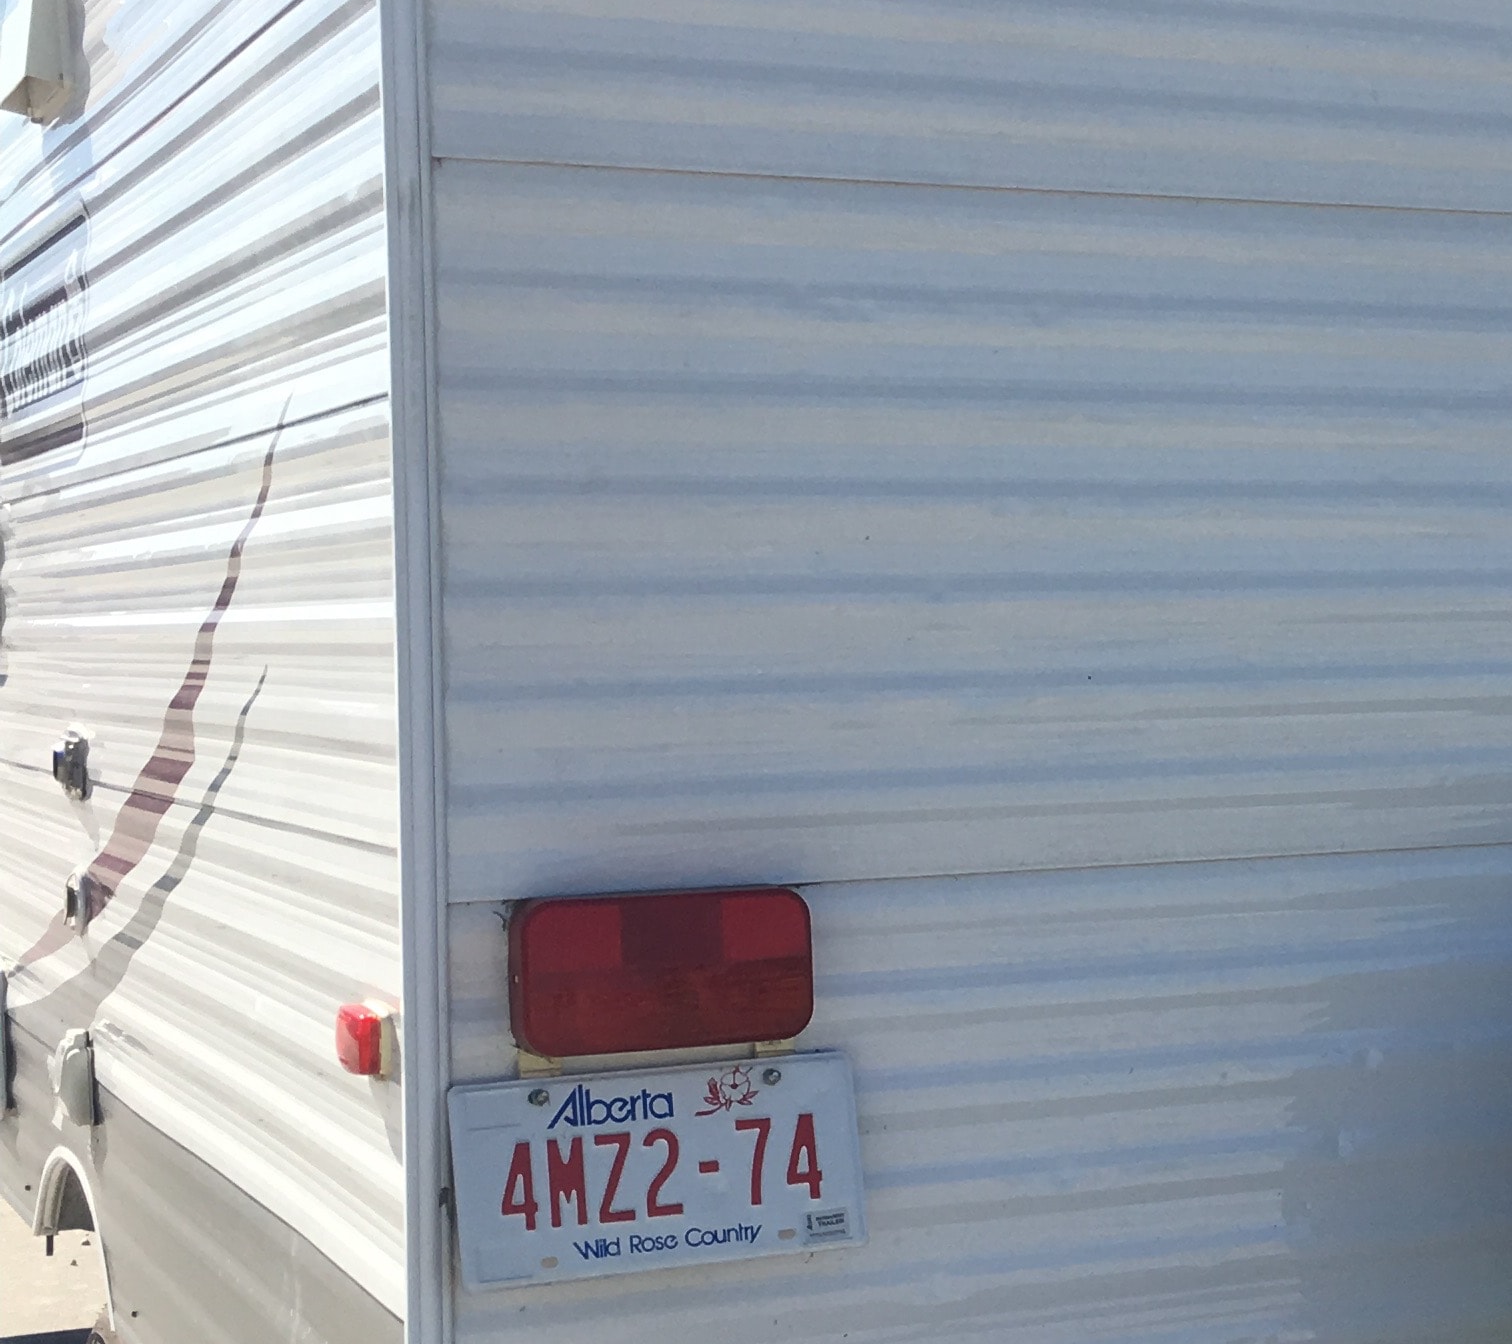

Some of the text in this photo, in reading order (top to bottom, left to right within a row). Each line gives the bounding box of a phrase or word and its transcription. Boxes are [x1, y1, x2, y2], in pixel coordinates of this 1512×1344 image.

[547, 1084, 675, 1130] Alberta
[501, 1113, 823, 1231] 4MZ2-74
[573, 1222, 763, 1260] Wild Rose Country
